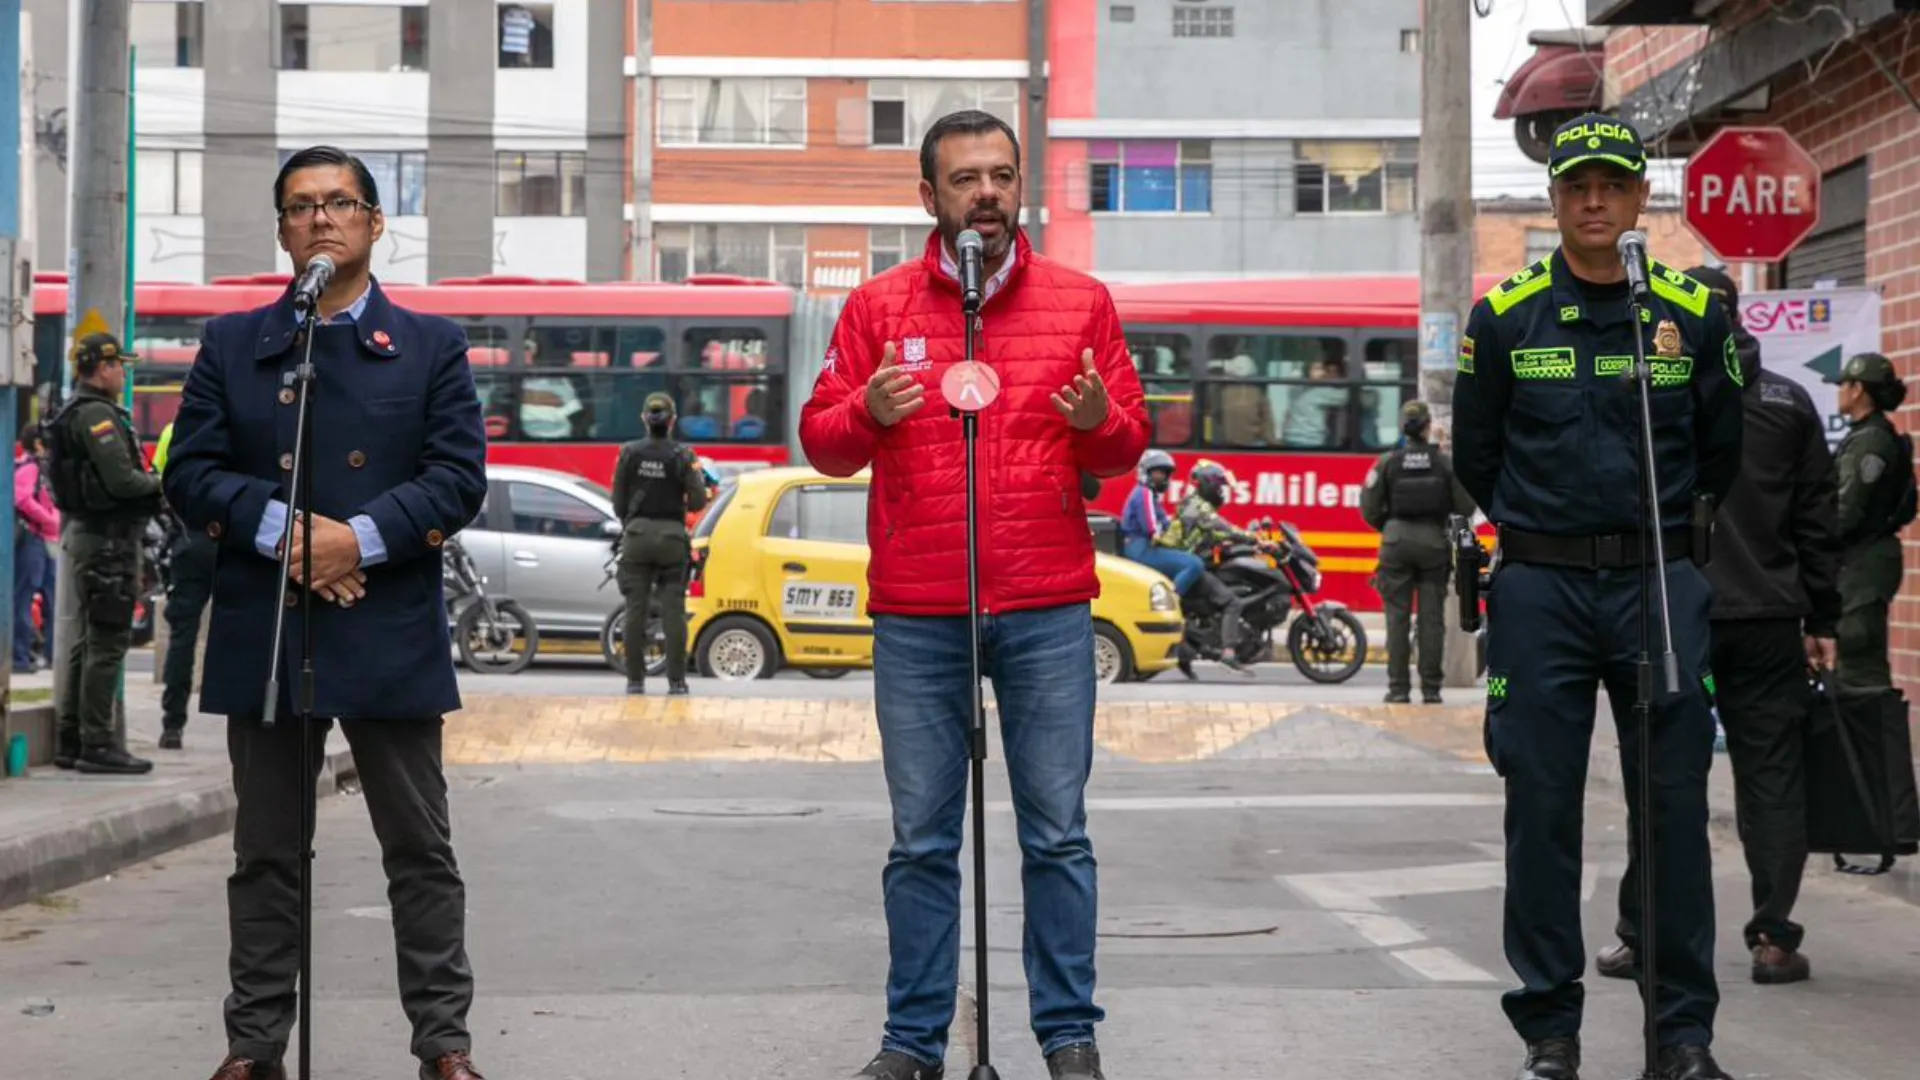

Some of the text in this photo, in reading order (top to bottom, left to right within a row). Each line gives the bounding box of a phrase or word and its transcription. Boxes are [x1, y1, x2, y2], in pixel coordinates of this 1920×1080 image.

[1556, 122, 1634, 148] POLICÍA
[1700, 174, 1803, 215] PARE
[785, 587, 856, 608] SMY 863
